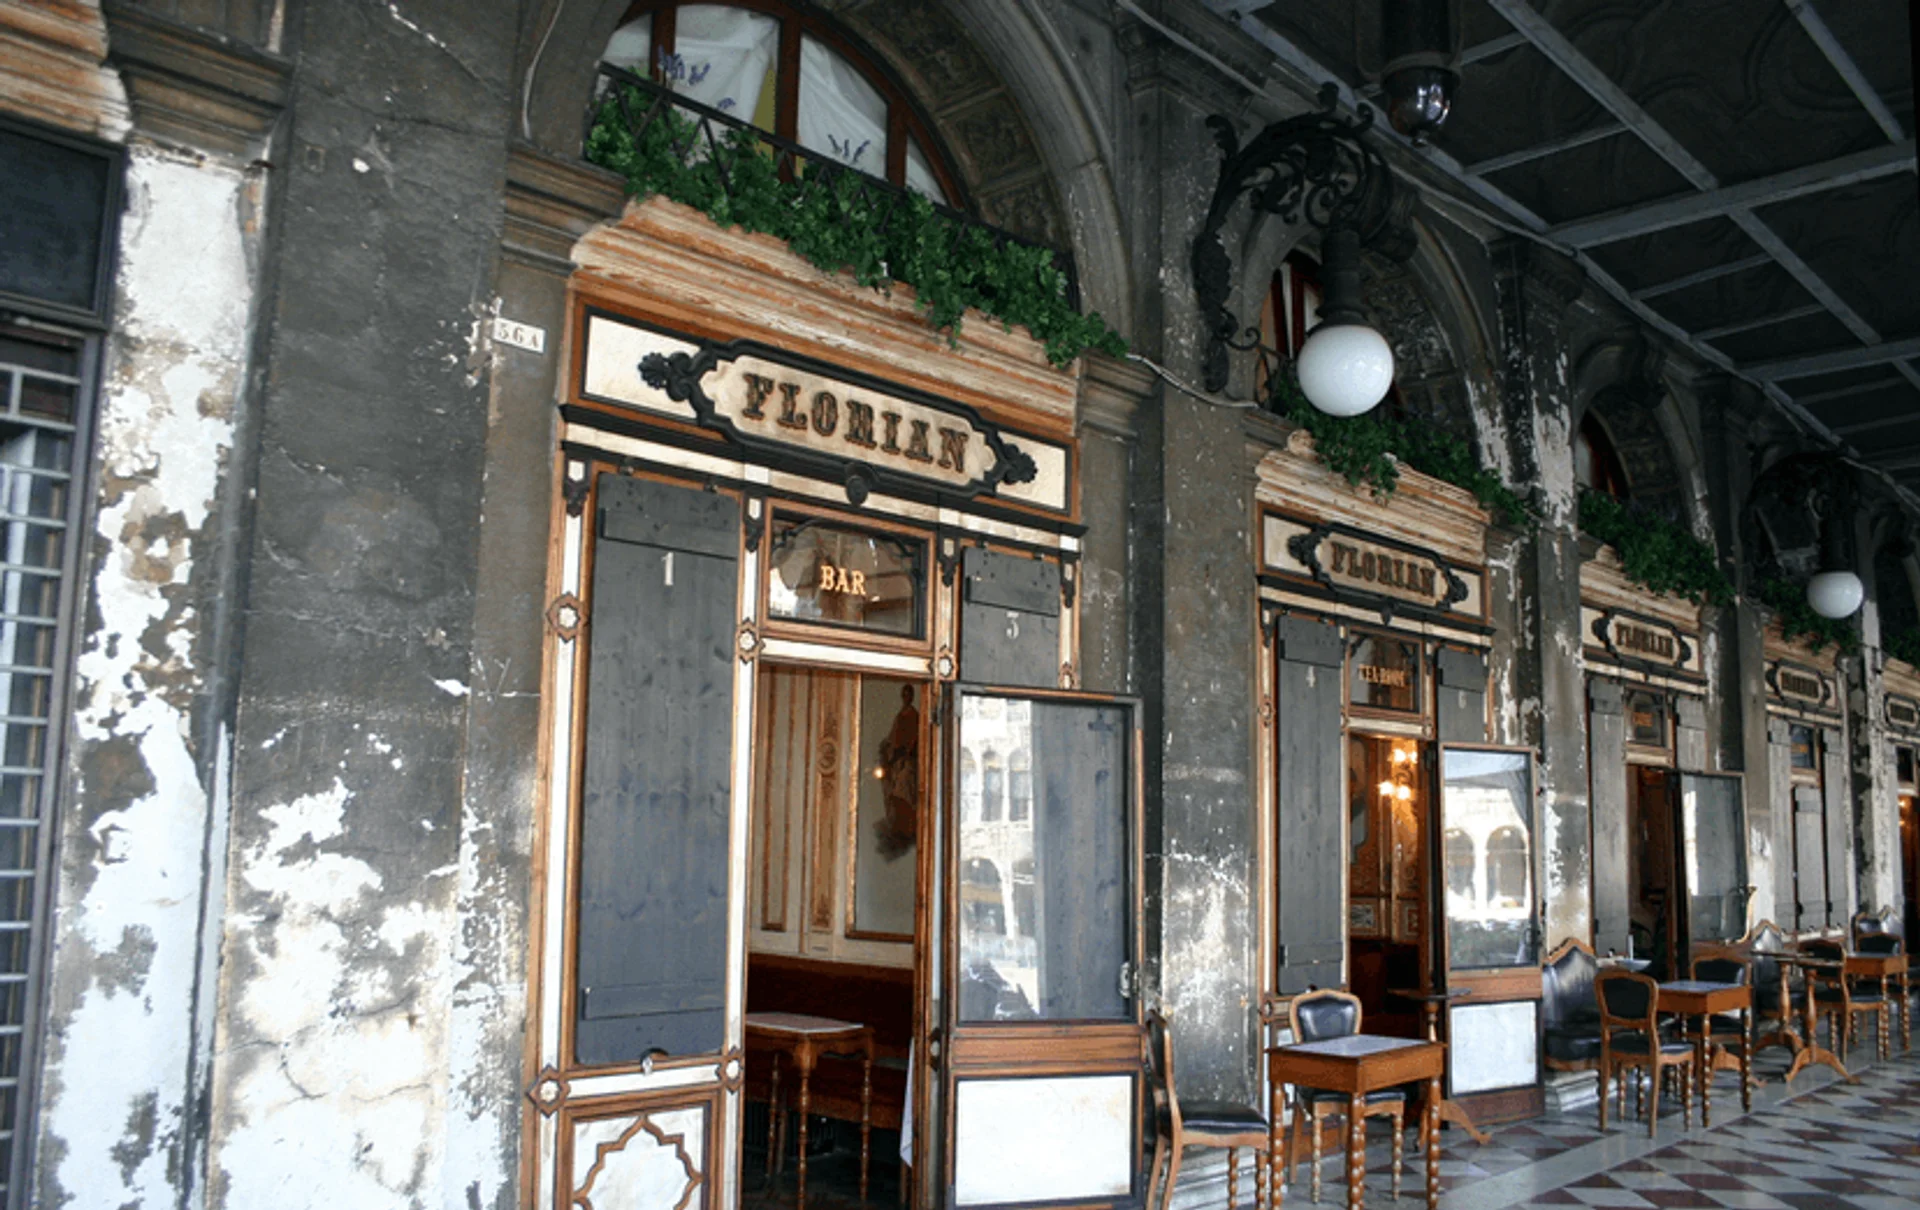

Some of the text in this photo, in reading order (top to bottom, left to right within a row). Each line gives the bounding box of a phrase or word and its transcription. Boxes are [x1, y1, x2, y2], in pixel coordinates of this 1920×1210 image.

[742, 373, 969, 473] FLORIAN
[661, 552, 675, 586] 1
[820, 565, 866, 595] BAR
[1331, 541, 1436, 597] FLORIAN
